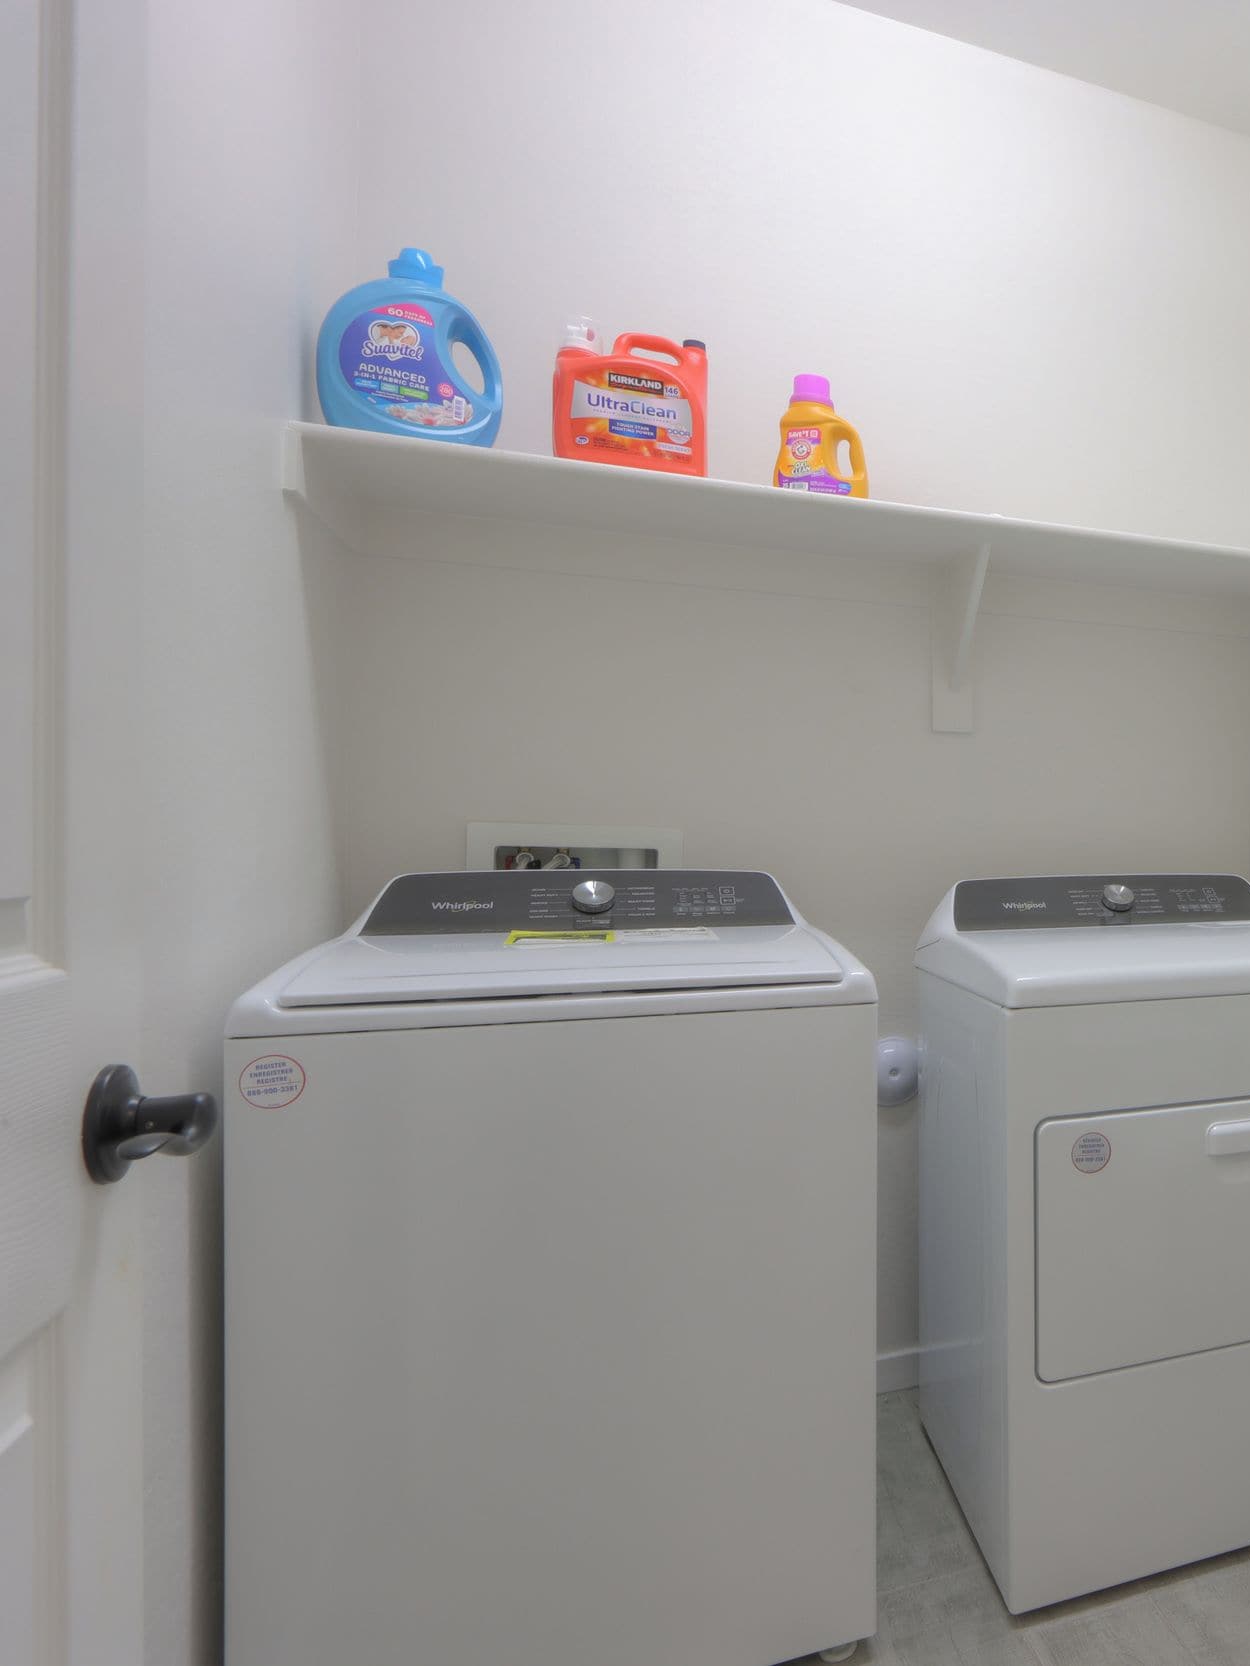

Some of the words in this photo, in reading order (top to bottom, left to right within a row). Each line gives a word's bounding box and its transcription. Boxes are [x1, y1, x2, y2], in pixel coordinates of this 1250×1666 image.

[388, 307, 404, 317] 60
[363, 341, 423, 360] Suavitel
[360, 363, 426, 384] ADVANCED
[378, 375, 407, 386] FABRIC
[409, 383, 430, 392] CARE
[610, 373, 662, 390] KIRKLAND
[665, 386, 678, 396] 146
[587, 393, 677, 420] UltraClean
[431, 901, 493, 913] Whirlpool
[1002, 902, 1046, 911] Whirlpool
[255, 1062, 287, 1070] REGISTER
